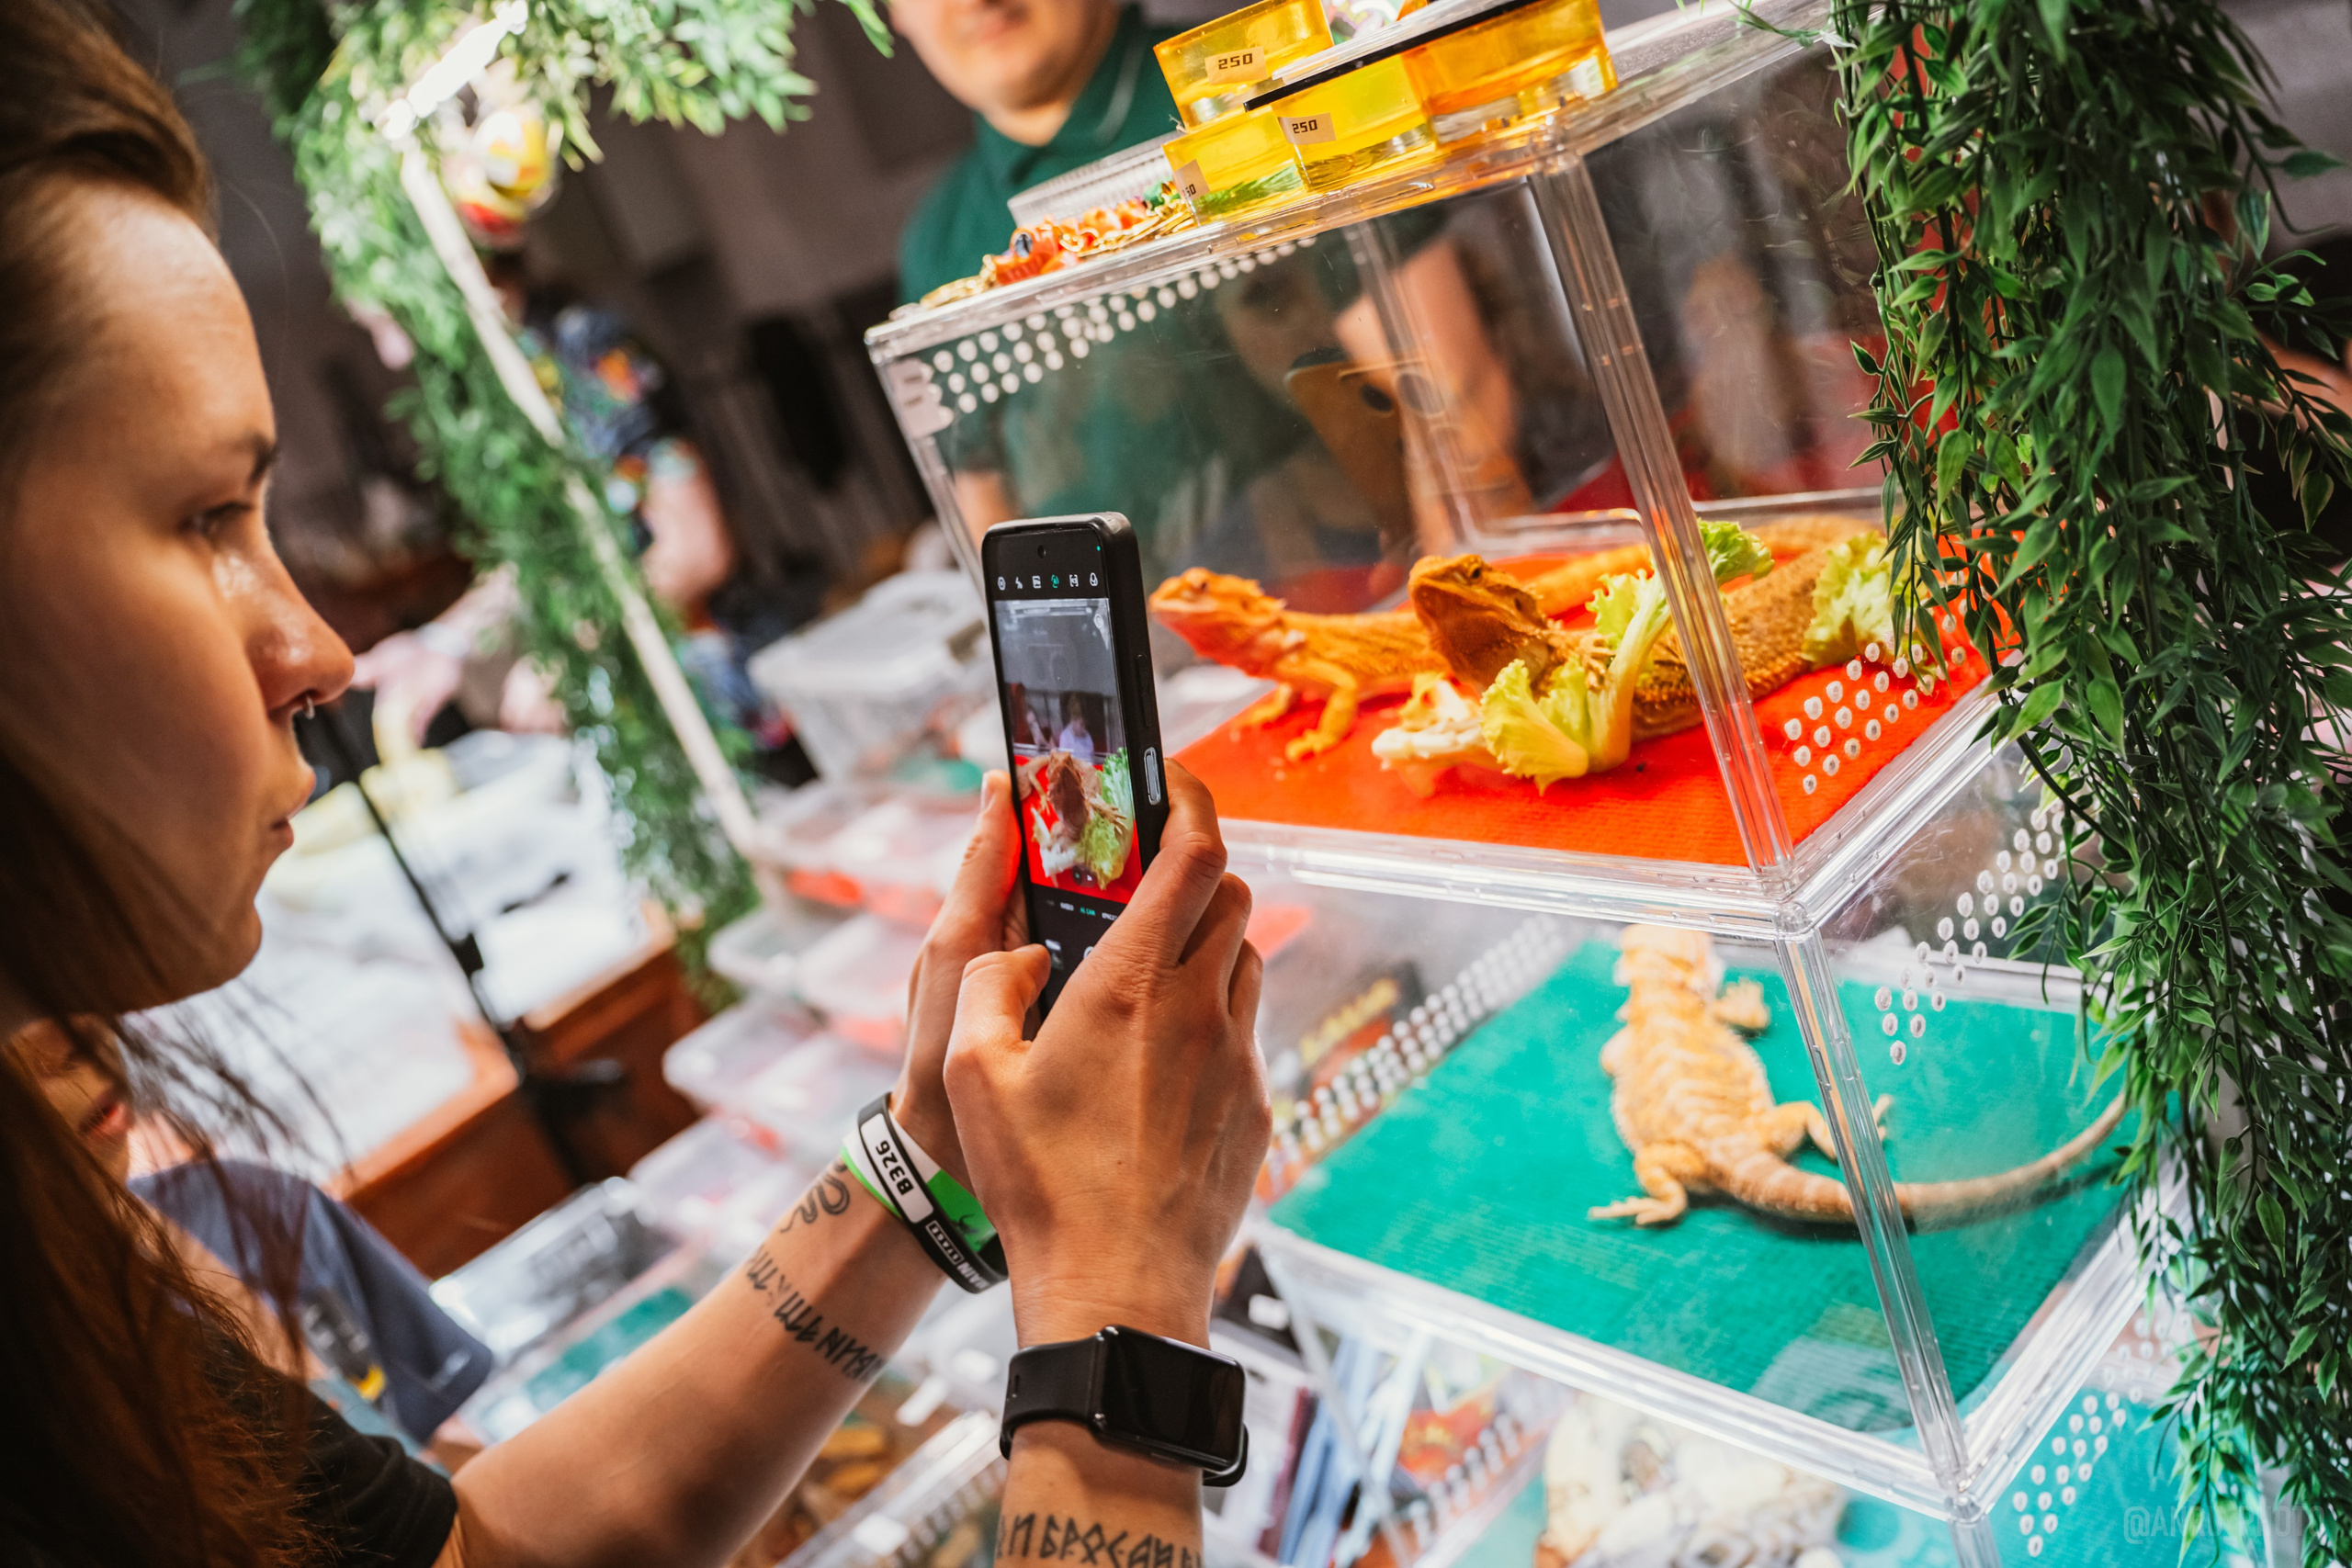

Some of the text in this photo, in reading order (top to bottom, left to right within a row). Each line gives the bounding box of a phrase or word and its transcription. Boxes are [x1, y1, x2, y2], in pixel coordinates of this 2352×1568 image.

[1218, 52, 1253, 70] 250
[1292, 118, 1317, 134] 250
[876, 1140, 914, 1196] B326
[930, 1226, 962, 1262] STAGE
